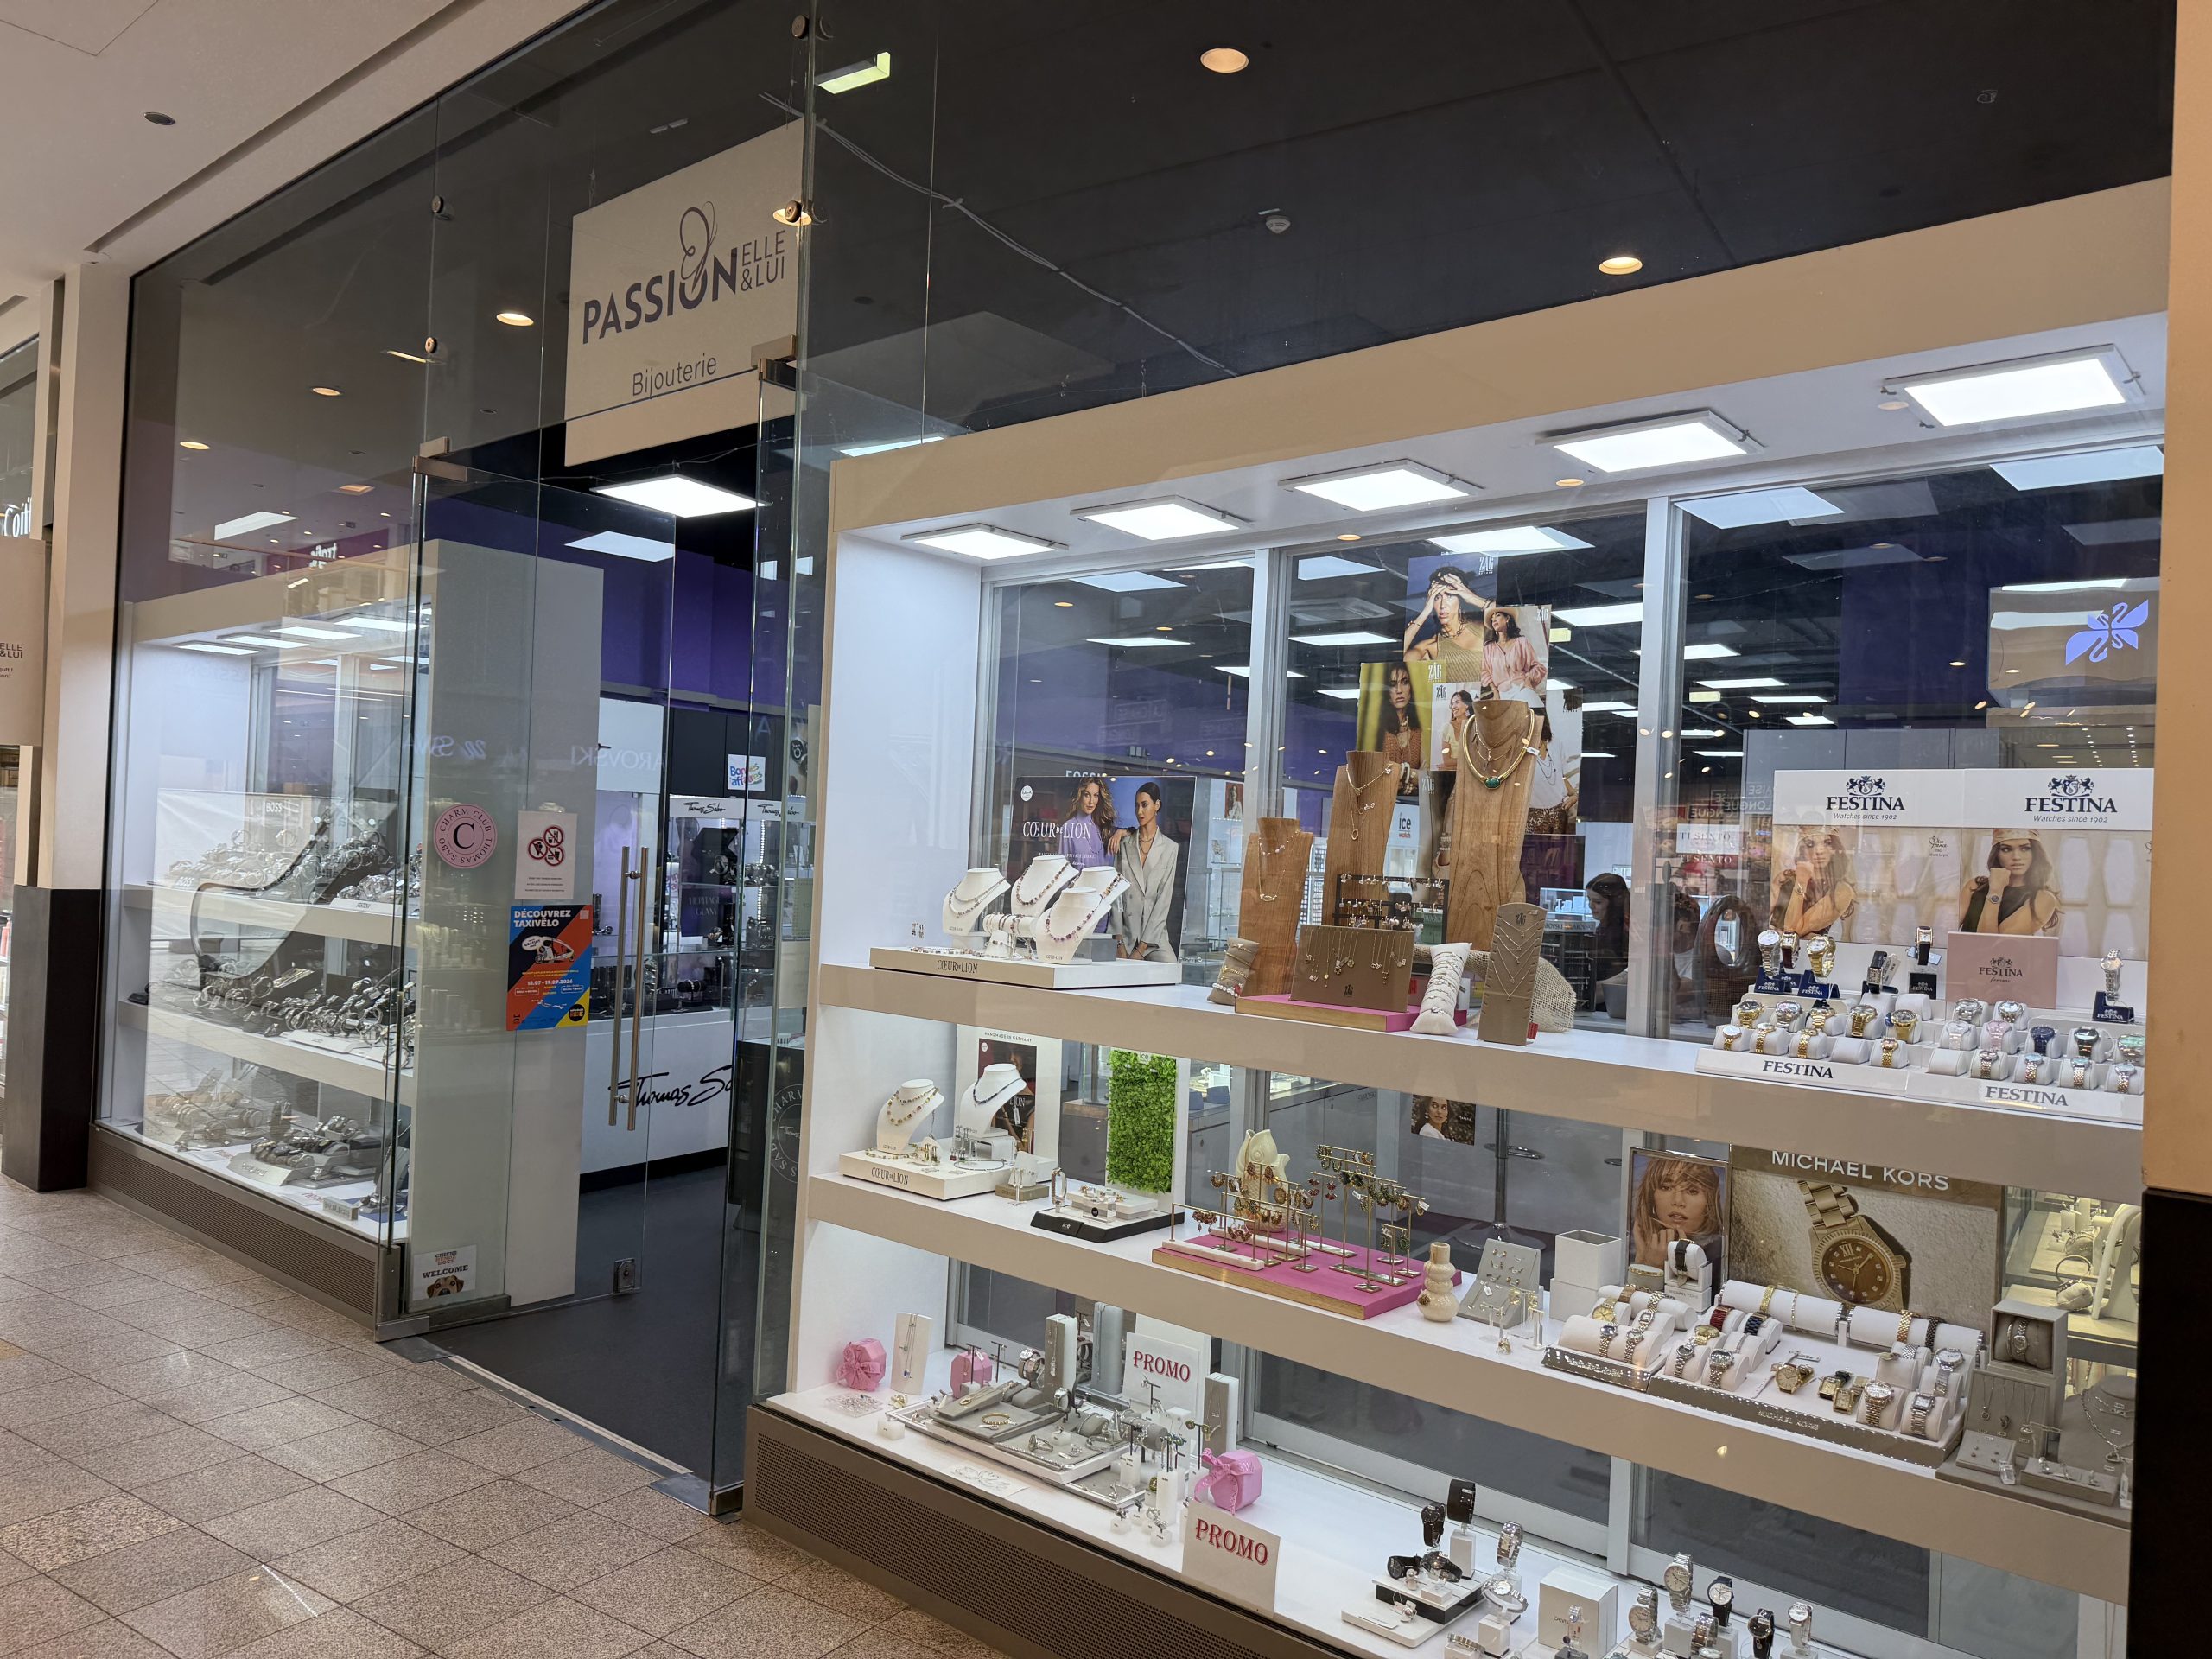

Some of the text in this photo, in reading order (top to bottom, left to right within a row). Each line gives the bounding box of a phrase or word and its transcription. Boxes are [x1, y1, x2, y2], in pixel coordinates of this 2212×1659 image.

[741, 257, 785, 292] &LUI
[582, 230, 786, 345] PASSION ELLE
[632, 353, 718, 399] Bijouterie
[1428, 662, 1442, 681] ZAG
[265, 802, 283, 813] BOSS
[1826, 797, 1906, 811] FESTINA
[2024, 798, 2119, 813] FESTINA
[1023, 821, 1057, 838] CŒUR
[1063, 823, 1093, 840] LION
[1399, 812, 1412, 830] ice
[438, 808, 493, 864] CHARM CLUB THOMAS SABO
[453, 823, 476, 849] C
[1694, 856, 1732, 865] SENTO
[514, 909, 572, 918] DÉCOUVREZ
[937, 959, 957, 972] CŒUR
[961, 962, 978, 974] LION
[1979, 966, 2024, 978] FESTINA
[1139, 1052, 1149, 1060] ice
[1763, 1059, 1834, 1079] FESTINA
[1985, 1085, 2069, 1107] FESTINA
[871, 1166, 889, 1182] CŒUR
[893, 1172, 909, 1185] LION
[1771, 1150, 1949, 1191] MICHAEL KORS
[422, 1264, 469, 1279] WELCOME
[1133, 1350, 1191, 1382] PROMO
[1196, 1517, 1268, 1566] PROMO
